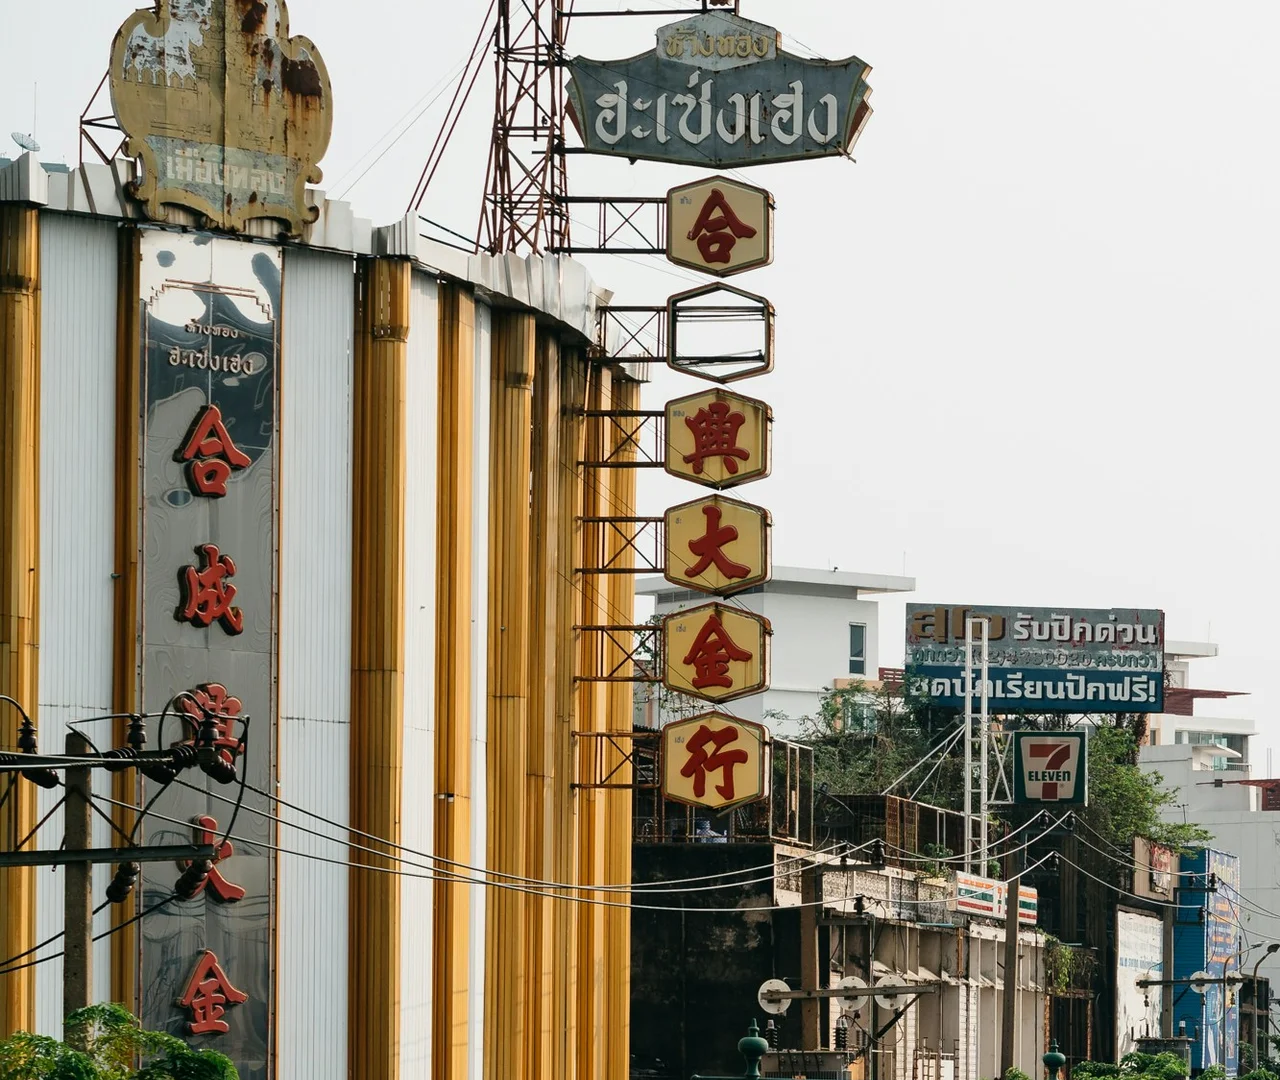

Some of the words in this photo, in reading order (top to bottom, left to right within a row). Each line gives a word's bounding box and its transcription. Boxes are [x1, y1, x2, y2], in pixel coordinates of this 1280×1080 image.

[667, 25, 769, 57] ห้างทอง
[595, 70, 838, 145] ฮะเซ่งเฮง
[687, 188, 757, 263] 合
[684, 504, 751, 579] 大
[683, 614, 752, 688] 金
[1014, 613, 1157, 643] รับปักด่วน
[680, 725, 748, 800] 行
[1030, 744, 1070, 799] 7
